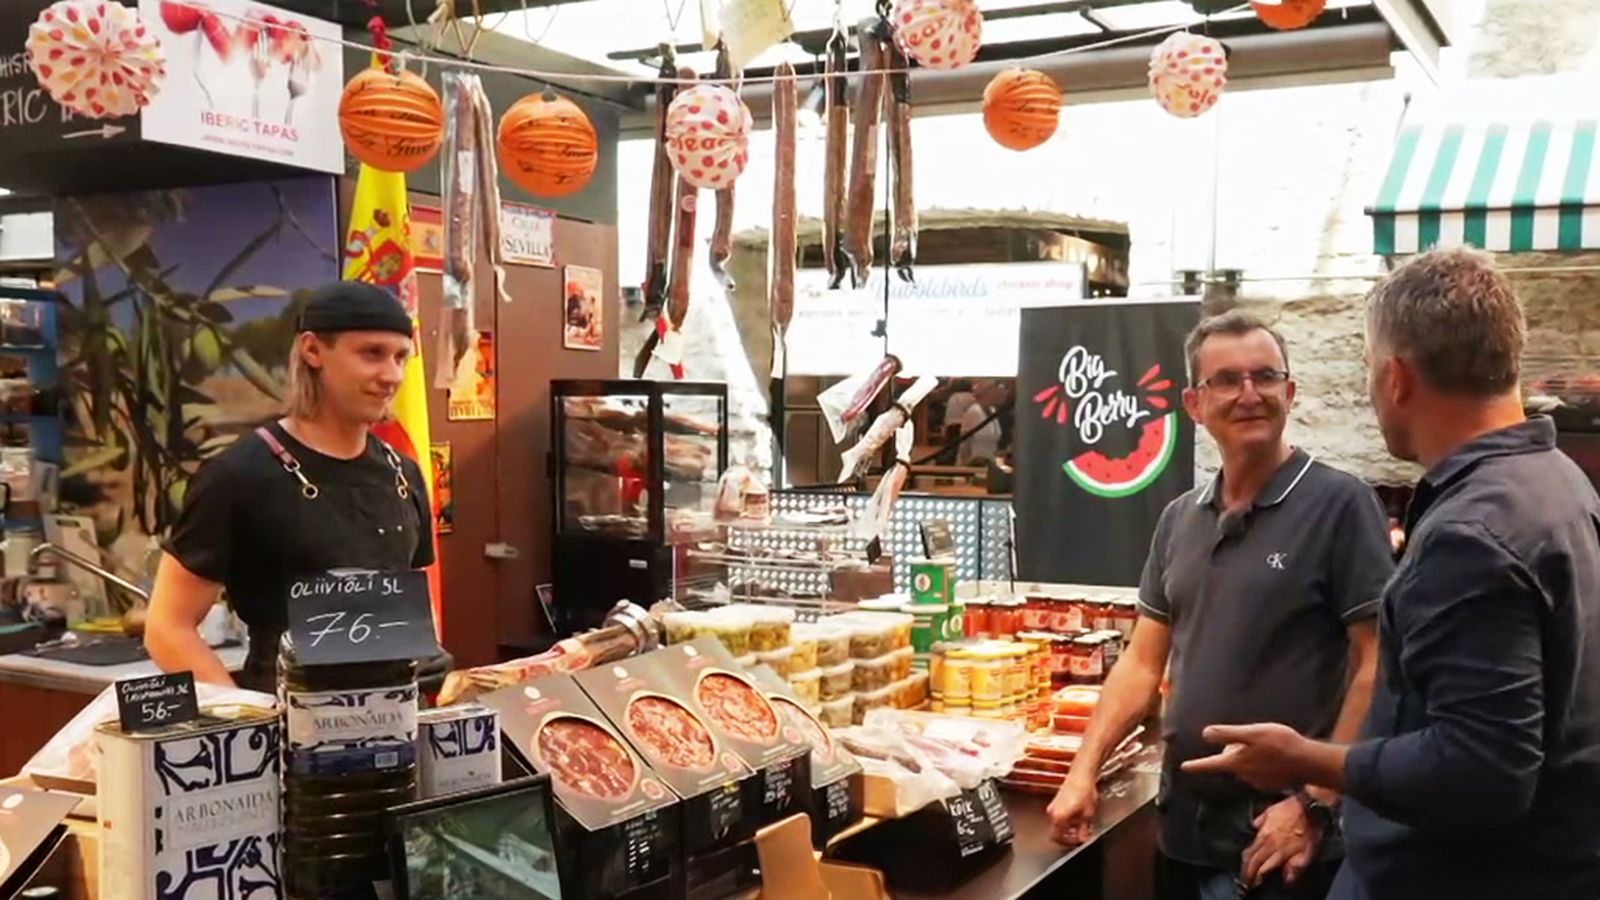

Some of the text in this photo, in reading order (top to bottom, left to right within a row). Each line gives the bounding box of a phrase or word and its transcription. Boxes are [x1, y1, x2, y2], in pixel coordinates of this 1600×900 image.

[201, 111, 299, 142] IBERIC TAPAS
[504, 234, 549, 257] SEVILLA
[1058, 345, 1118, 398] Big
[1074, 389, 1151, 444] Berry
[312, 712, 403, 730] ARBONAIDA
[177, 791, 273, 822] ARBONAIDA
